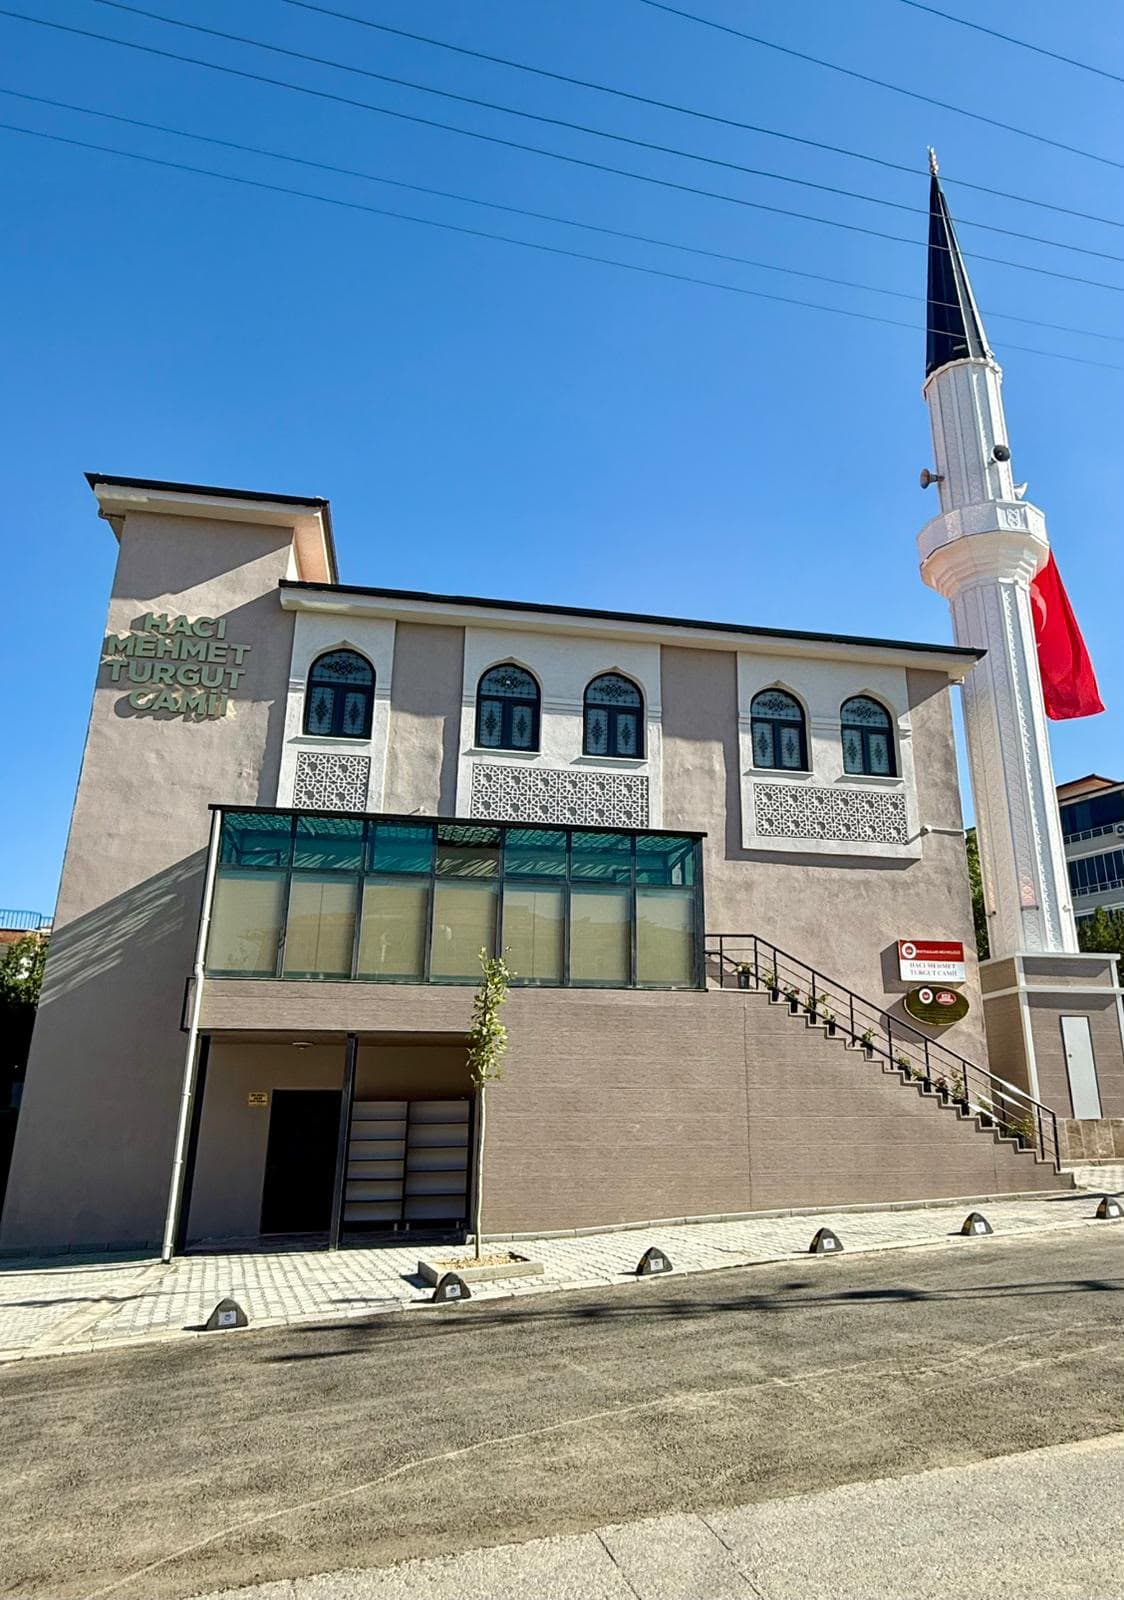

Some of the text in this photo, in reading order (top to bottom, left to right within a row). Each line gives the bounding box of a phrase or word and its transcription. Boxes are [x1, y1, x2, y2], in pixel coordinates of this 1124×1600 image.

[144, 612, 226, 640] HACI
[107, 635, 250, 665] MEHMET
[107, 660, 245, 689] TURGUT
